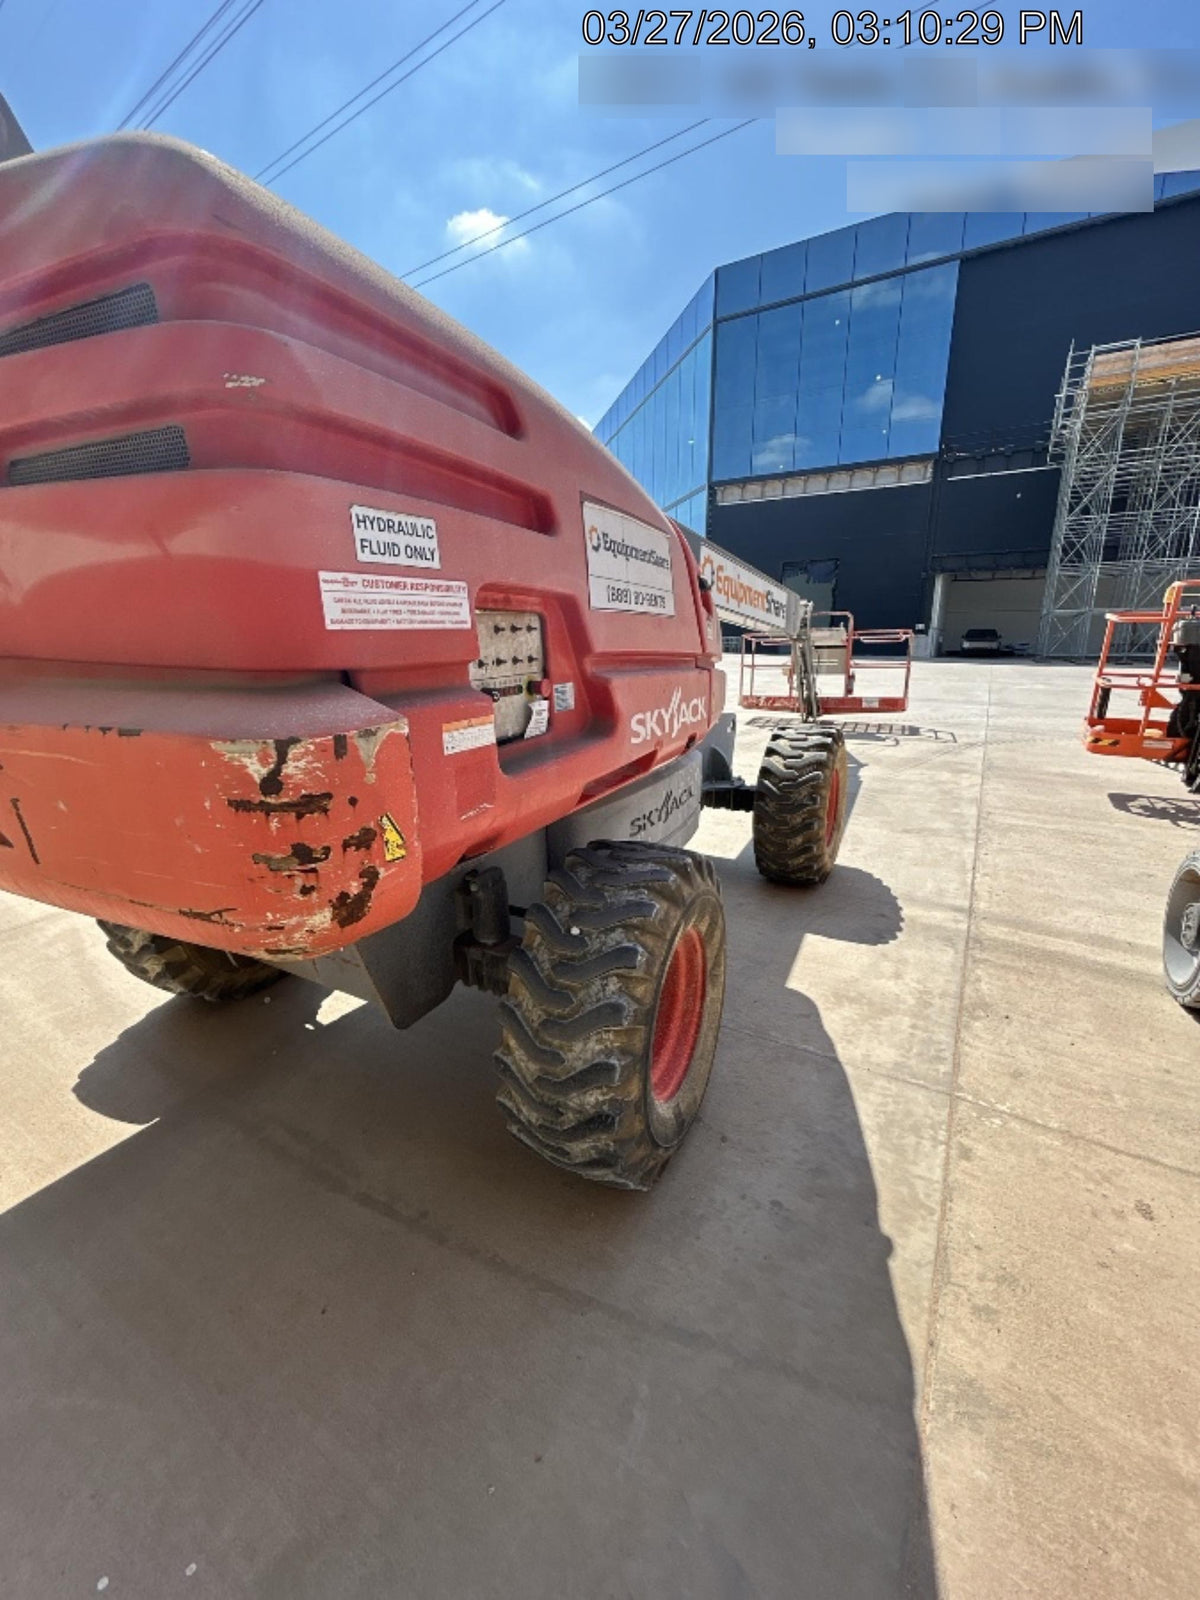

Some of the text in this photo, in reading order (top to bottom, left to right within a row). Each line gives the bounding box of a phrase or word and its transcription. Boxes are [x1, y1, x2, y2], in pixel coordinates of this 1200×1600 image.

[355, 512, 435, 540] HYDRAULIC
[360, 538, 437, 563] FLUID ONLY
[361, 578, 408, 592] CUSTOMER
[630, 686, 707, 744] SKYJACK
[629, 789, 695, 838] SKYJACK
